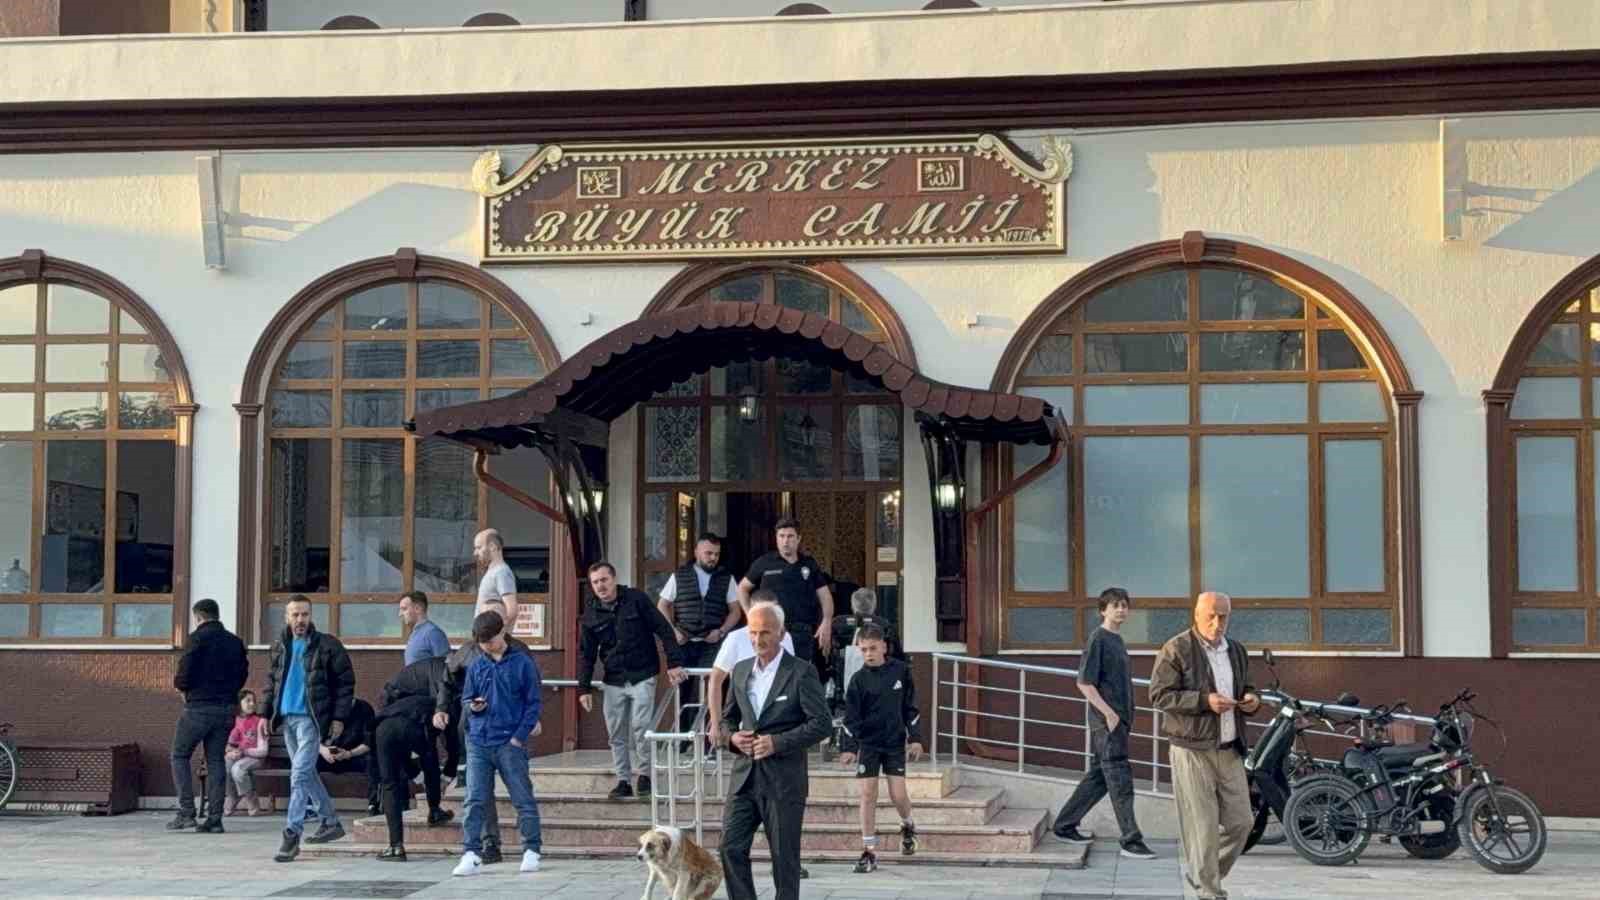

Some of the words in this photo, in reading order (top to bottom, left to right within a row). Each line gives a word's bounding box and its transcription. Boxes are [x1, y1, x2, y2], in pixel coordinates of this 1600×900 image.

[638, 158, 890, 195] MERKEZ
[525, 202, 745, 243] BÜYÜK
[802, 193, 1022, 238] CAMİİ
